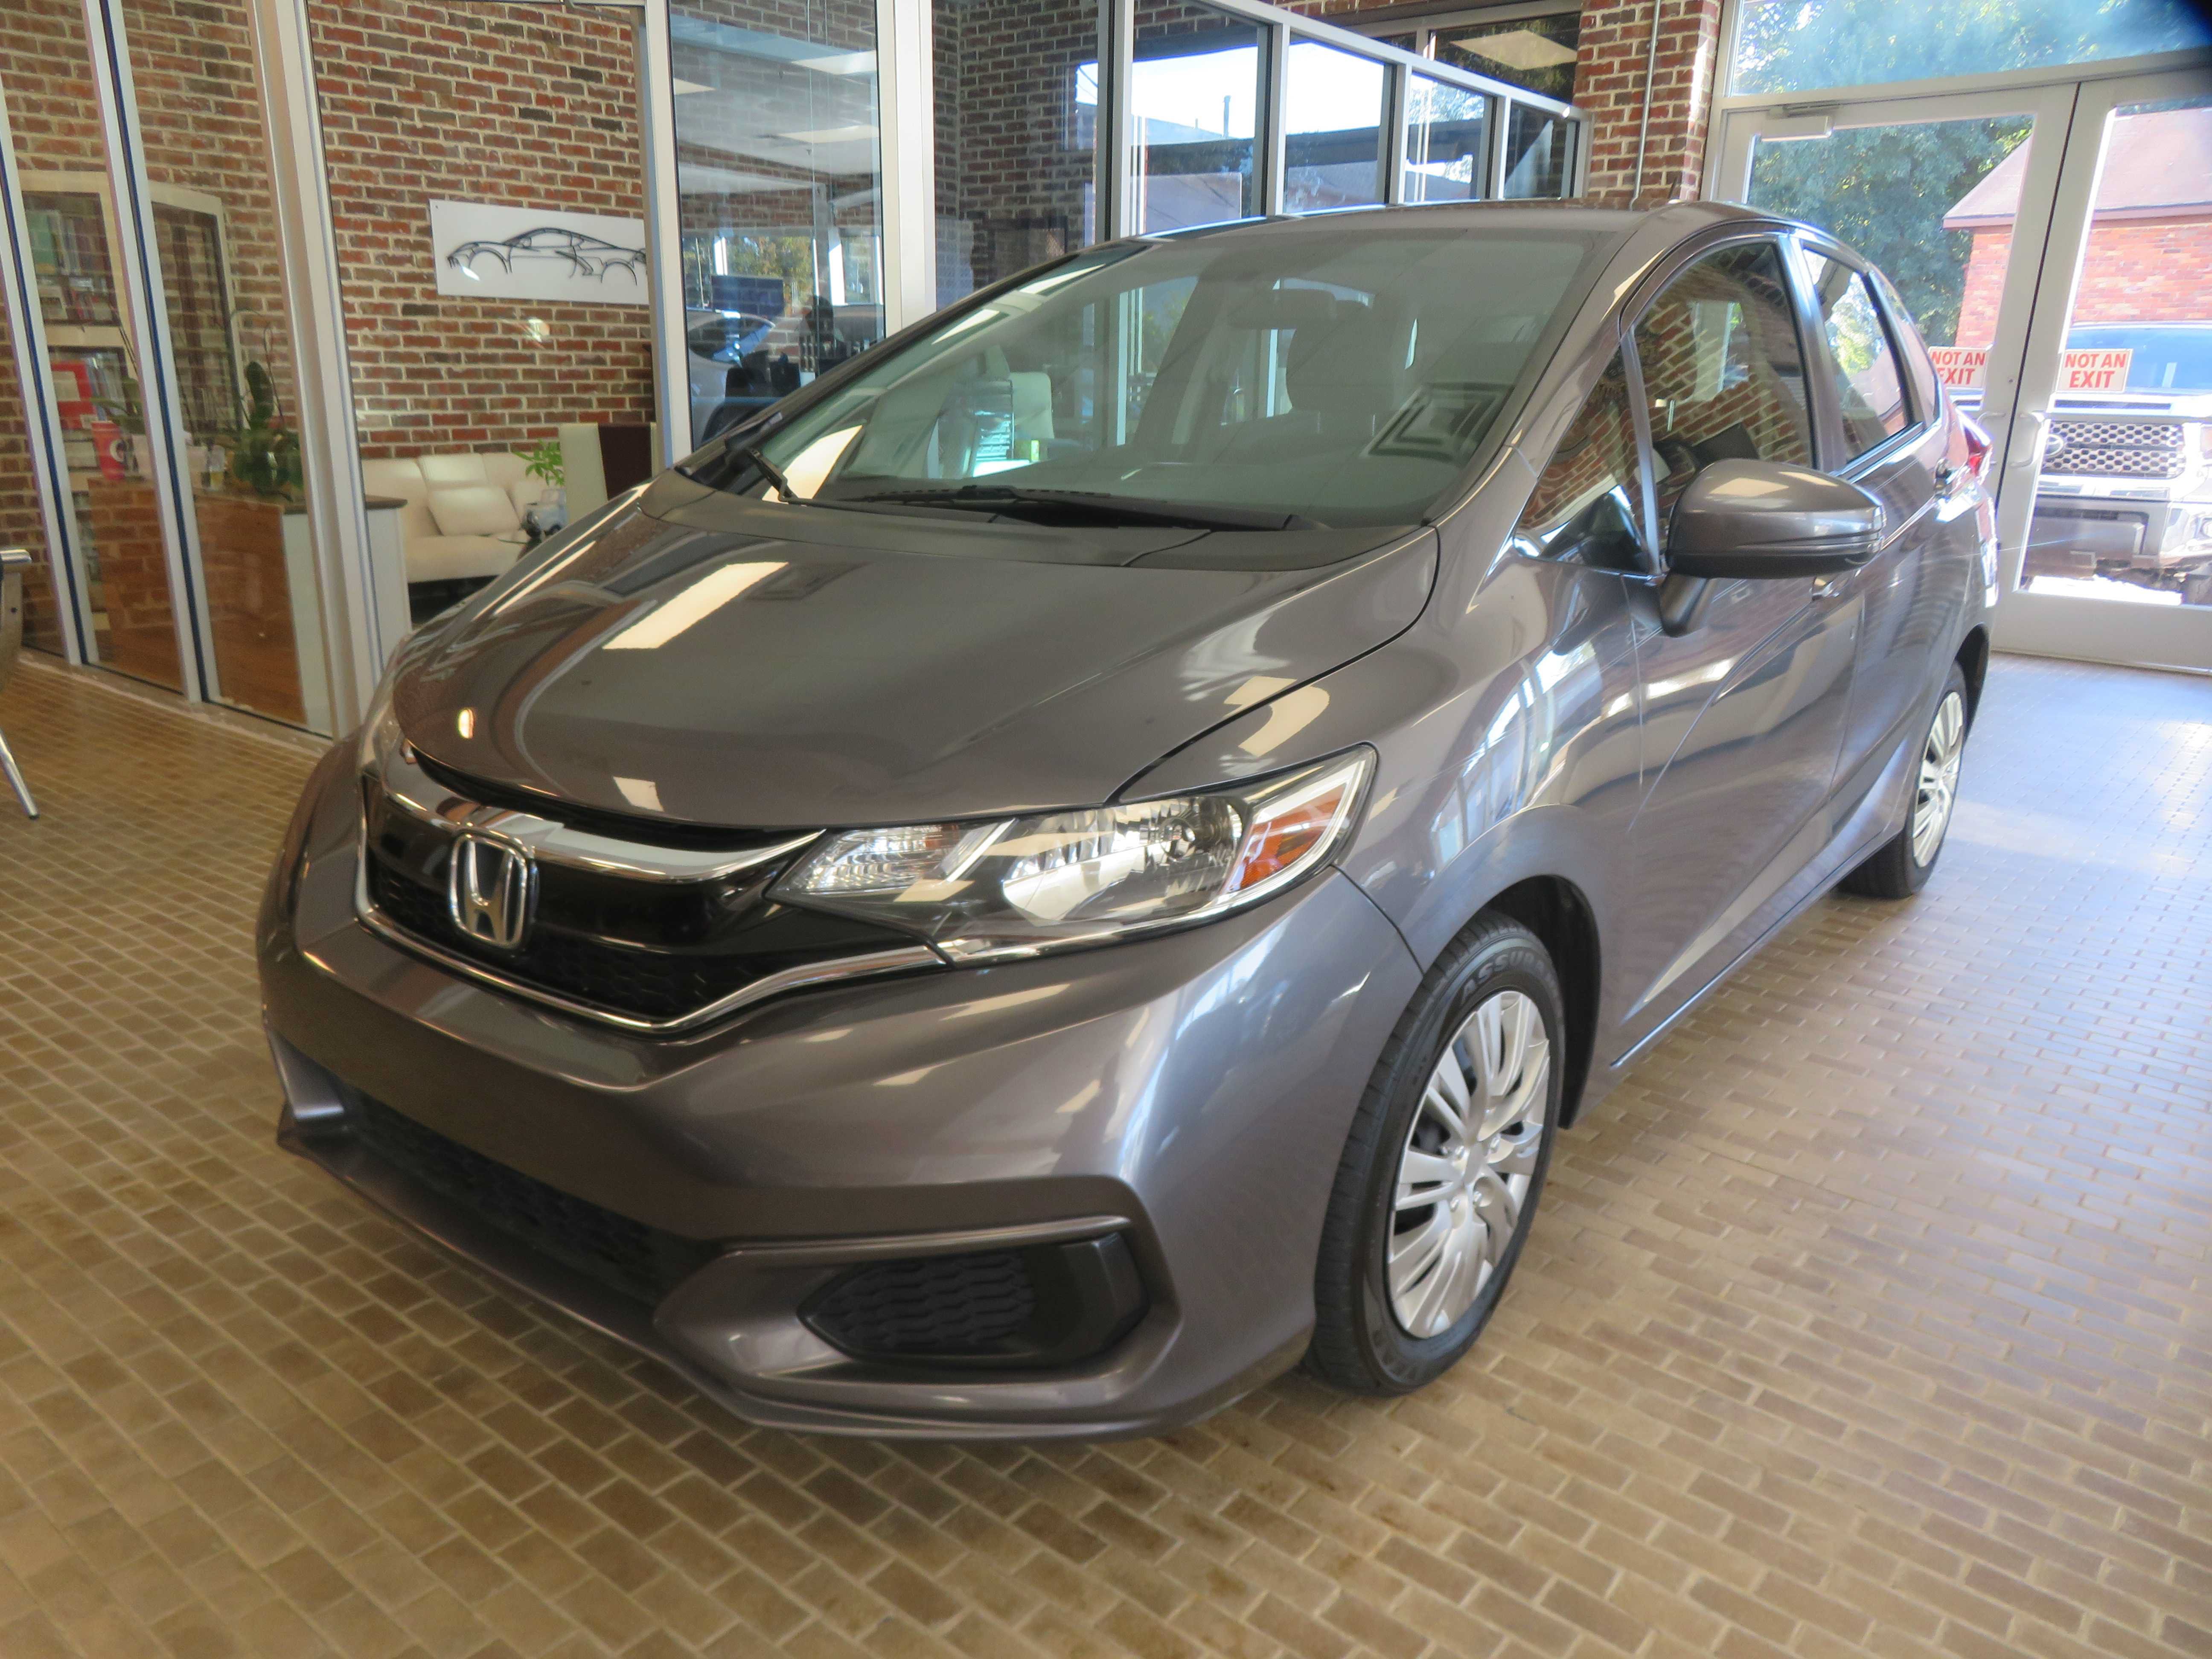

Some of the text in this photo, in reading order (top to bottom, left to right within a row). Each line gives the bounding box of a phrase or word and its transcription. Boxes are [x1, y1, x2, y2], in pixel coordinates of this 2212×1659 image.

[1932, 351, 1986, 366] NOT AN
[2064, 353, 2127, 368] NOT AN
[2069, 370, 2115, 388] EXIT
